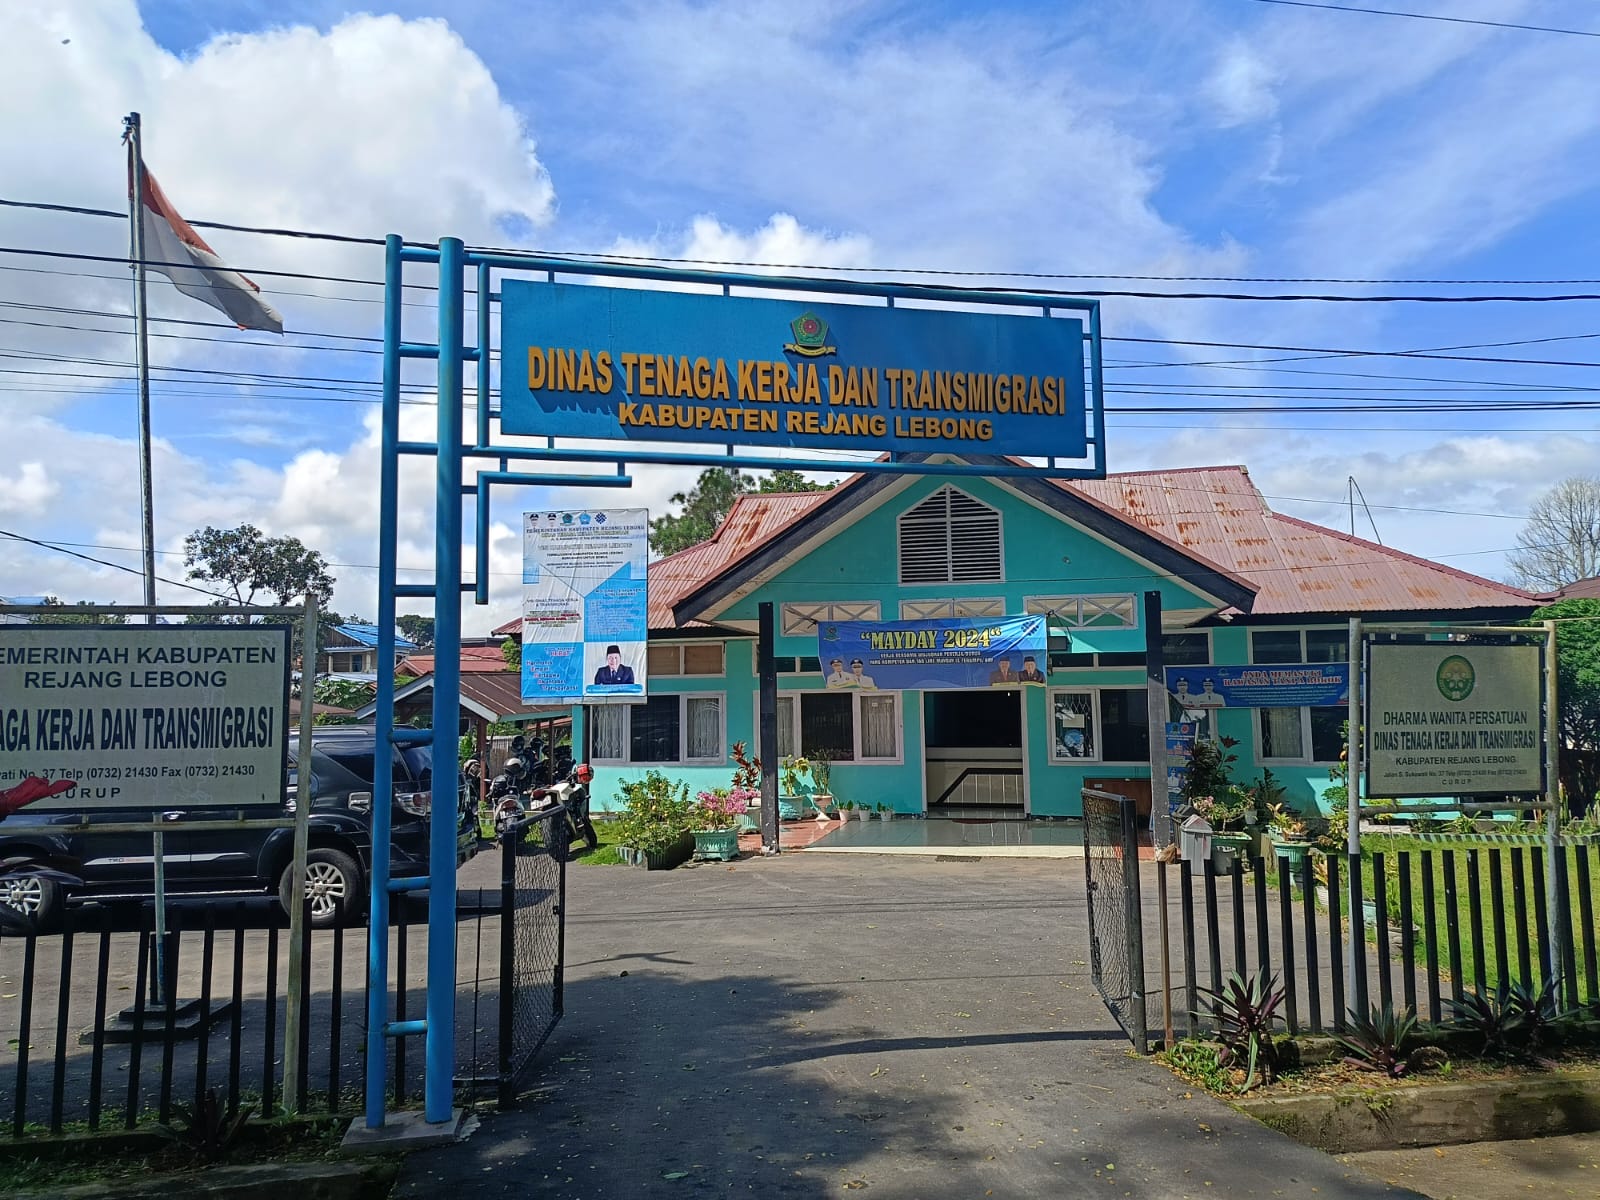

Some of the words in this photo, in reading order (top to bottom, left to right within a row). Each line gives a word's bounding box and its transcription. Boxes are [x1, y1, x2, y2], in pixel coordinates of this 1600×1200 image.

[528, 346, 613, 394] DINAS
[621, 352, 730, 400] TENAGA
[737, 360, 821, 404] KERJA
[829, 365, 879, 407] DAN
[885, 368, 1065, 415] TRANSMIGRASI
[619, 402, 778, 433] KABUPATEN
[786, 411, 886, 437] REJANG
[895, 416, 993, 440] LEBONG
[137, 647, 276, 664] KABUPATEN
[24, 671, 122, 688] REJANG
[131, 671, 227, 688] LEBONG
[1383, 712, 1427, 725] DHARMA
[1430, 712, 1467, 725] WANITA
[1469, 711, 1527, 724] PERSATUAN
[36, 708, 95, 751] KERJA
[101, 708, 137, 750] DAN
[143, 706, 273, 749] TRANSMIGRASI
[1374, 732, 1398, 750] DINAS
[1401, 731, 1432, 750] TENAGA
[1435, 731, 1459, 749] KERJA
[1462, 731, 1477, 749] DAN
[1479, 730, 1536, 749] TRANSMIGRASI
[1395, 756, 1446, 766] KABUPATEN
[1448, 756, 1480, 764] REJANG
[1482, 755, 1517, 764] LEBONG
[42, 769, 56, 779] 37
[59, 768, 83, 781] Telp
[87, 767, 122, 781] (0732)
[125, 766, 159, 778] 21430
[161, 766, 181, 778] Fax
[185, 765, 219, 779] (0732)
[222, 765, 255, 776] 21430
